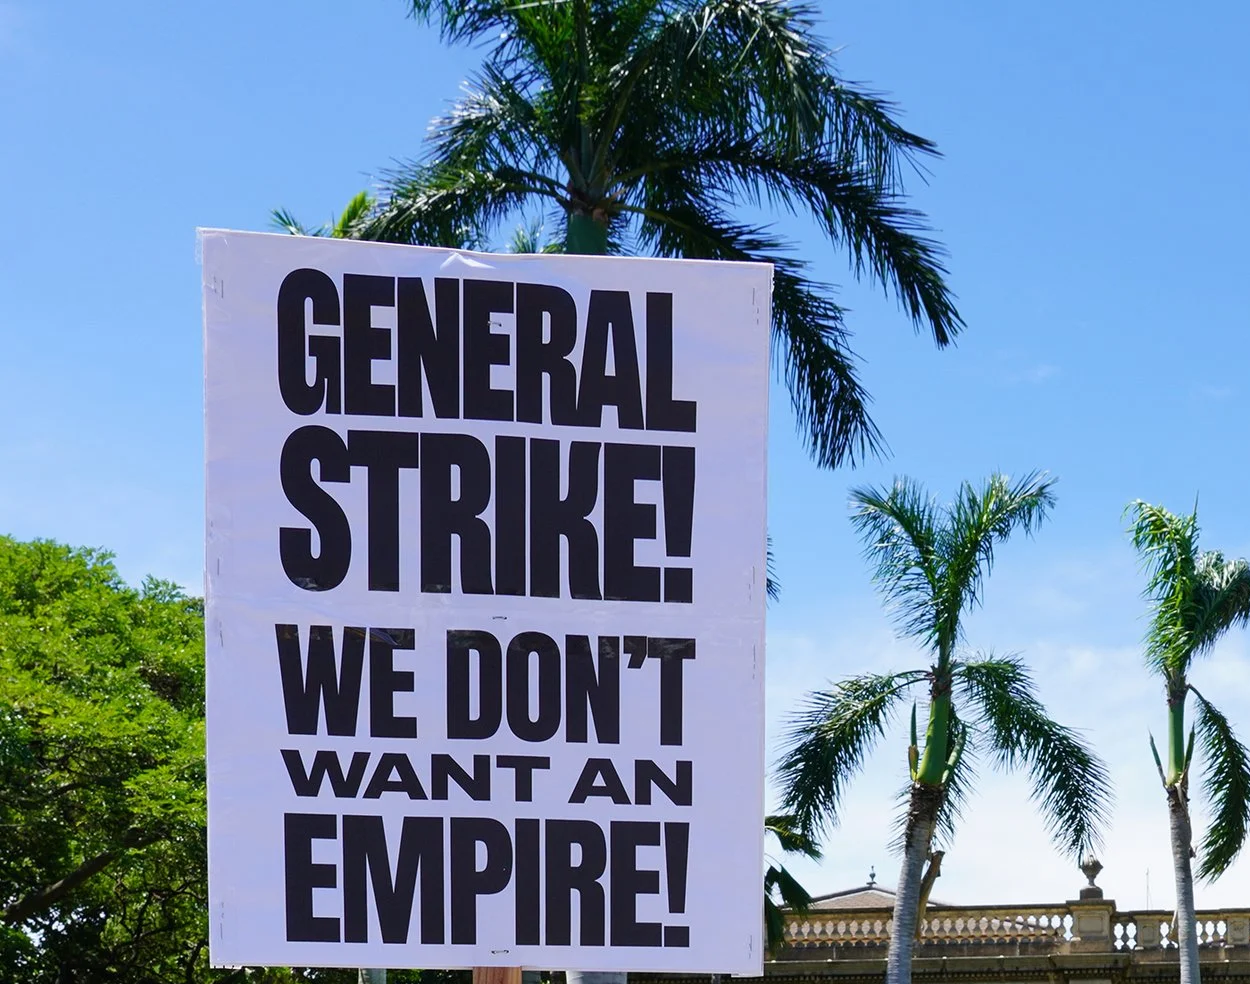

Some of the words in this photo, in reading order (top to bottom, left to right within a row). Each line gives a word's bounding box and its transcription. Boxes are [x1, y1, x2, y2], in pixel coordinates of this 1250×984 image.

[276, 267, 698, 433] GENERAL
[278, 425, 697, 604] STRIKE!
[275, 623, 418, 740] WE
[446, 629, 697, 747] DON'T
[280, 749, 551, 803] WANT
[567, 757, 694, 807] AN
[284, 812, 691, 948] EMPIRE!
